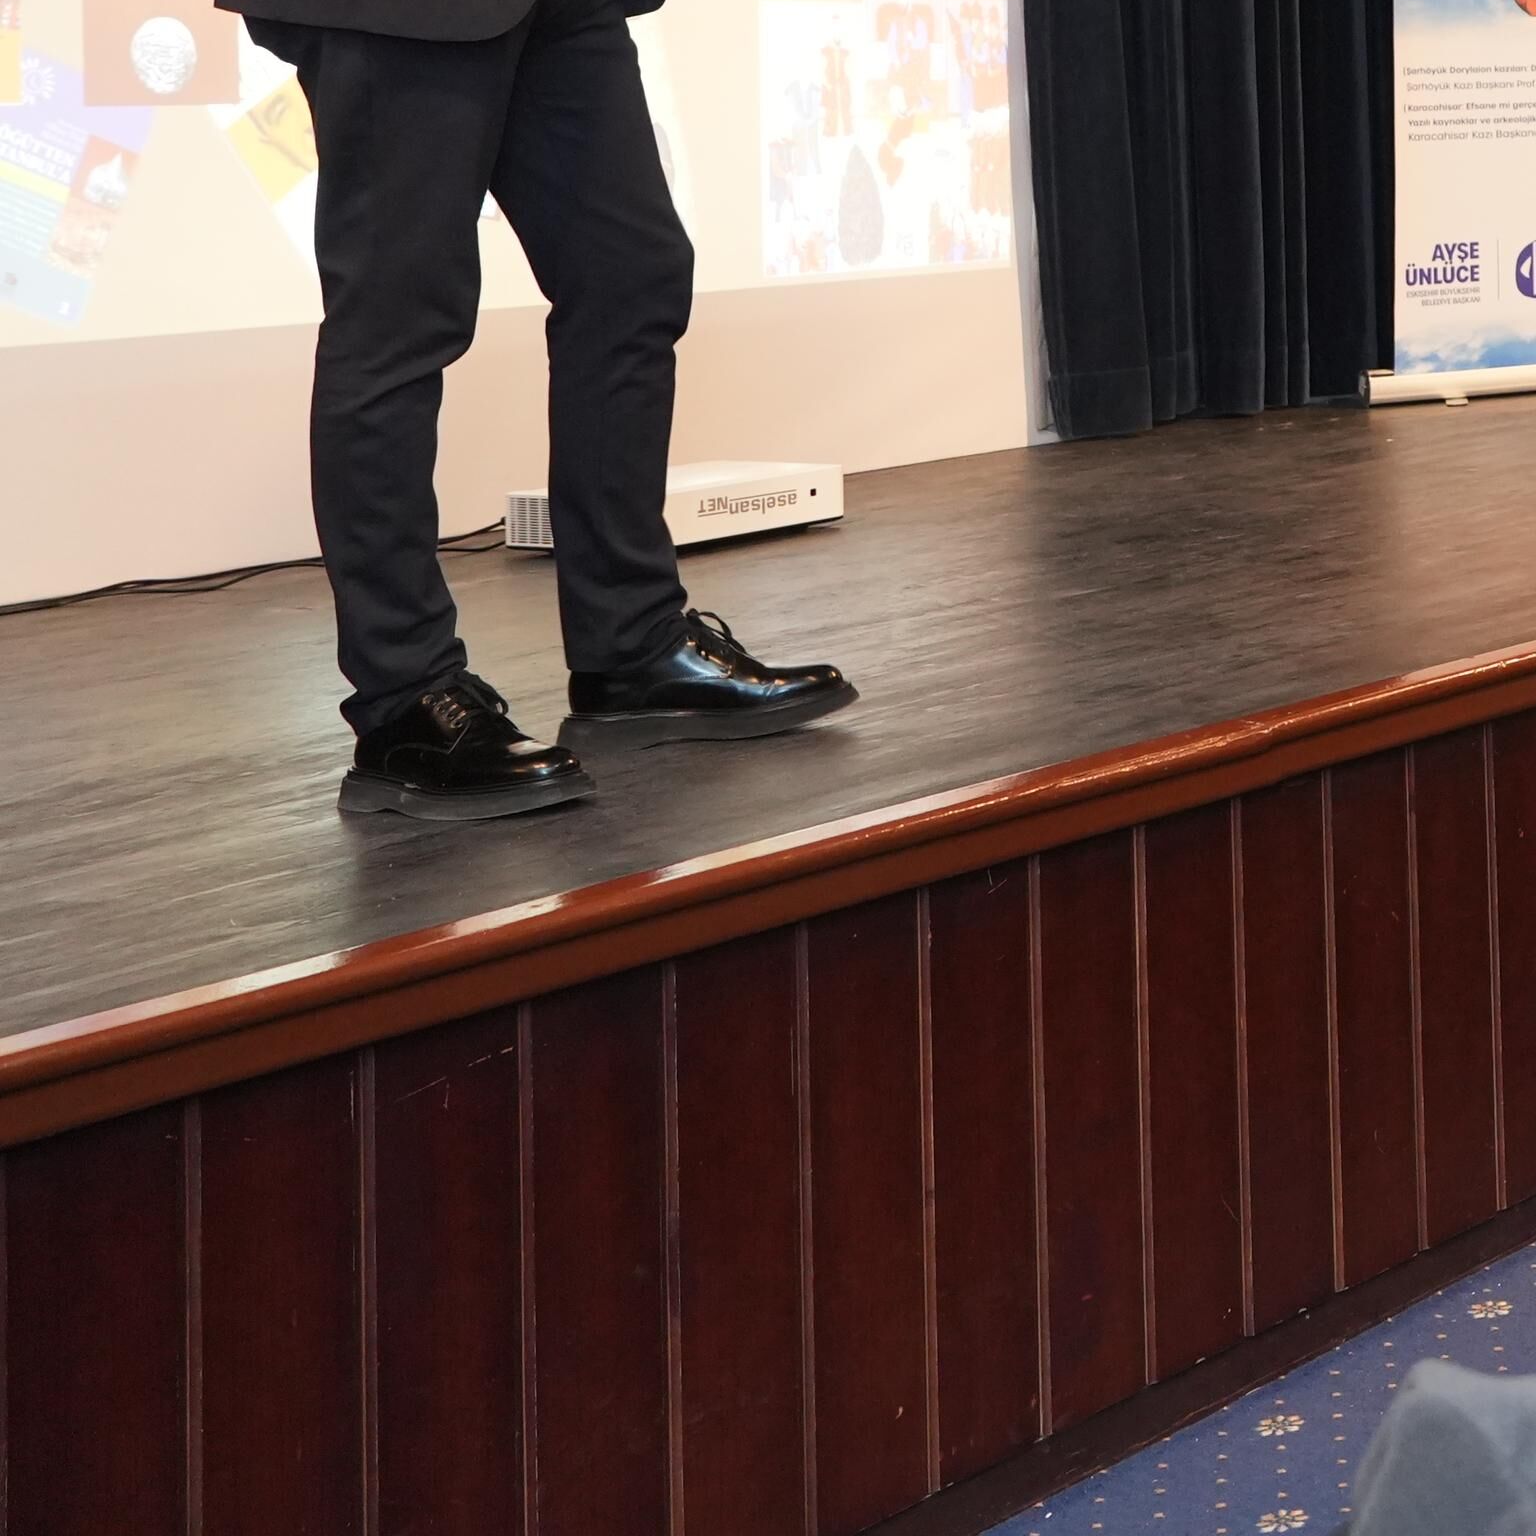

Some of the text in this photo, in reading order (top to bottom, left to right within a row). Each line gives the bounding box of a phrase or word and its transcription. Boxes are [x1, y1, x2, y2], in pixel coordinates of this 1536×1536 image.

[1465, 102, 1497, 111] Efsane
[1471, 130, 1493, 140] Kazı
[1495, 128, 1536, 140] Başkanı
[1431, 241, 1480, 263] AYŞE
[1405, 261, 1480, 287] ÜNLÜCE
